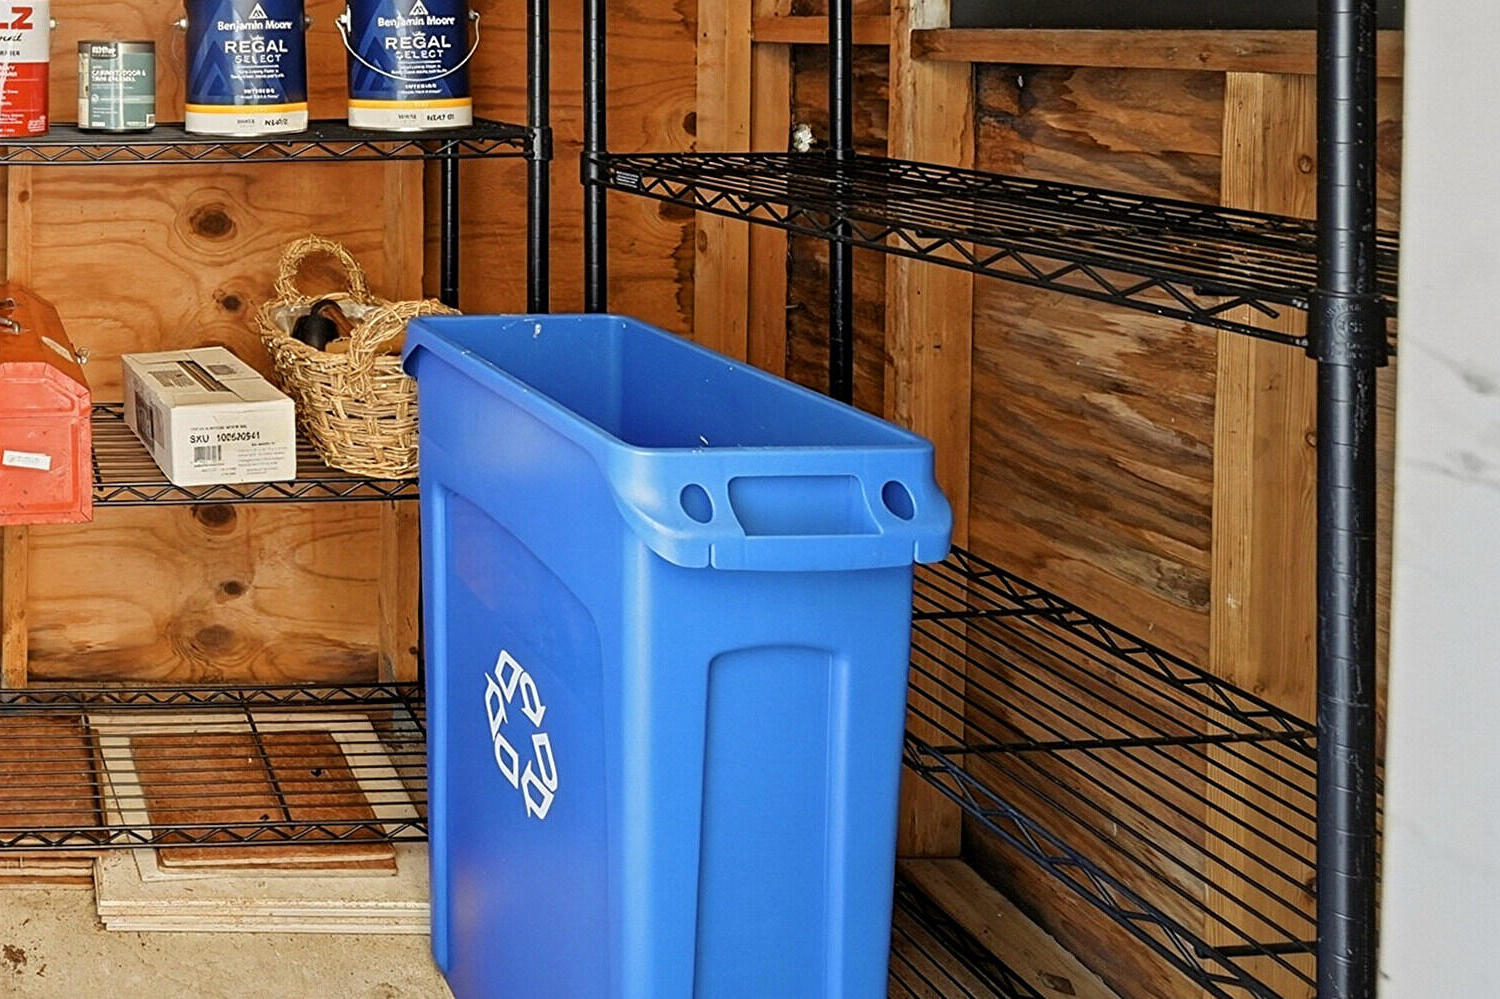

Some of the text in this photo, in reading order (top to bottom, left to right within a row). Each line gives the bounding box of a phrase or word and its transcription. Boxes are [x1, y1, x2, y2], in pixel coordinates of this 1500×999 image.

[217, 19, 293, 33] Benjamin Moore
[377, 14, 456, 29] Benjamin Moore
[224, 39, 289, 54] REGAL
[384, 35, 452, 50] REGAL
[234, 53, 282, 65] SELECT
[395, 49, 445, 60] SELECT
